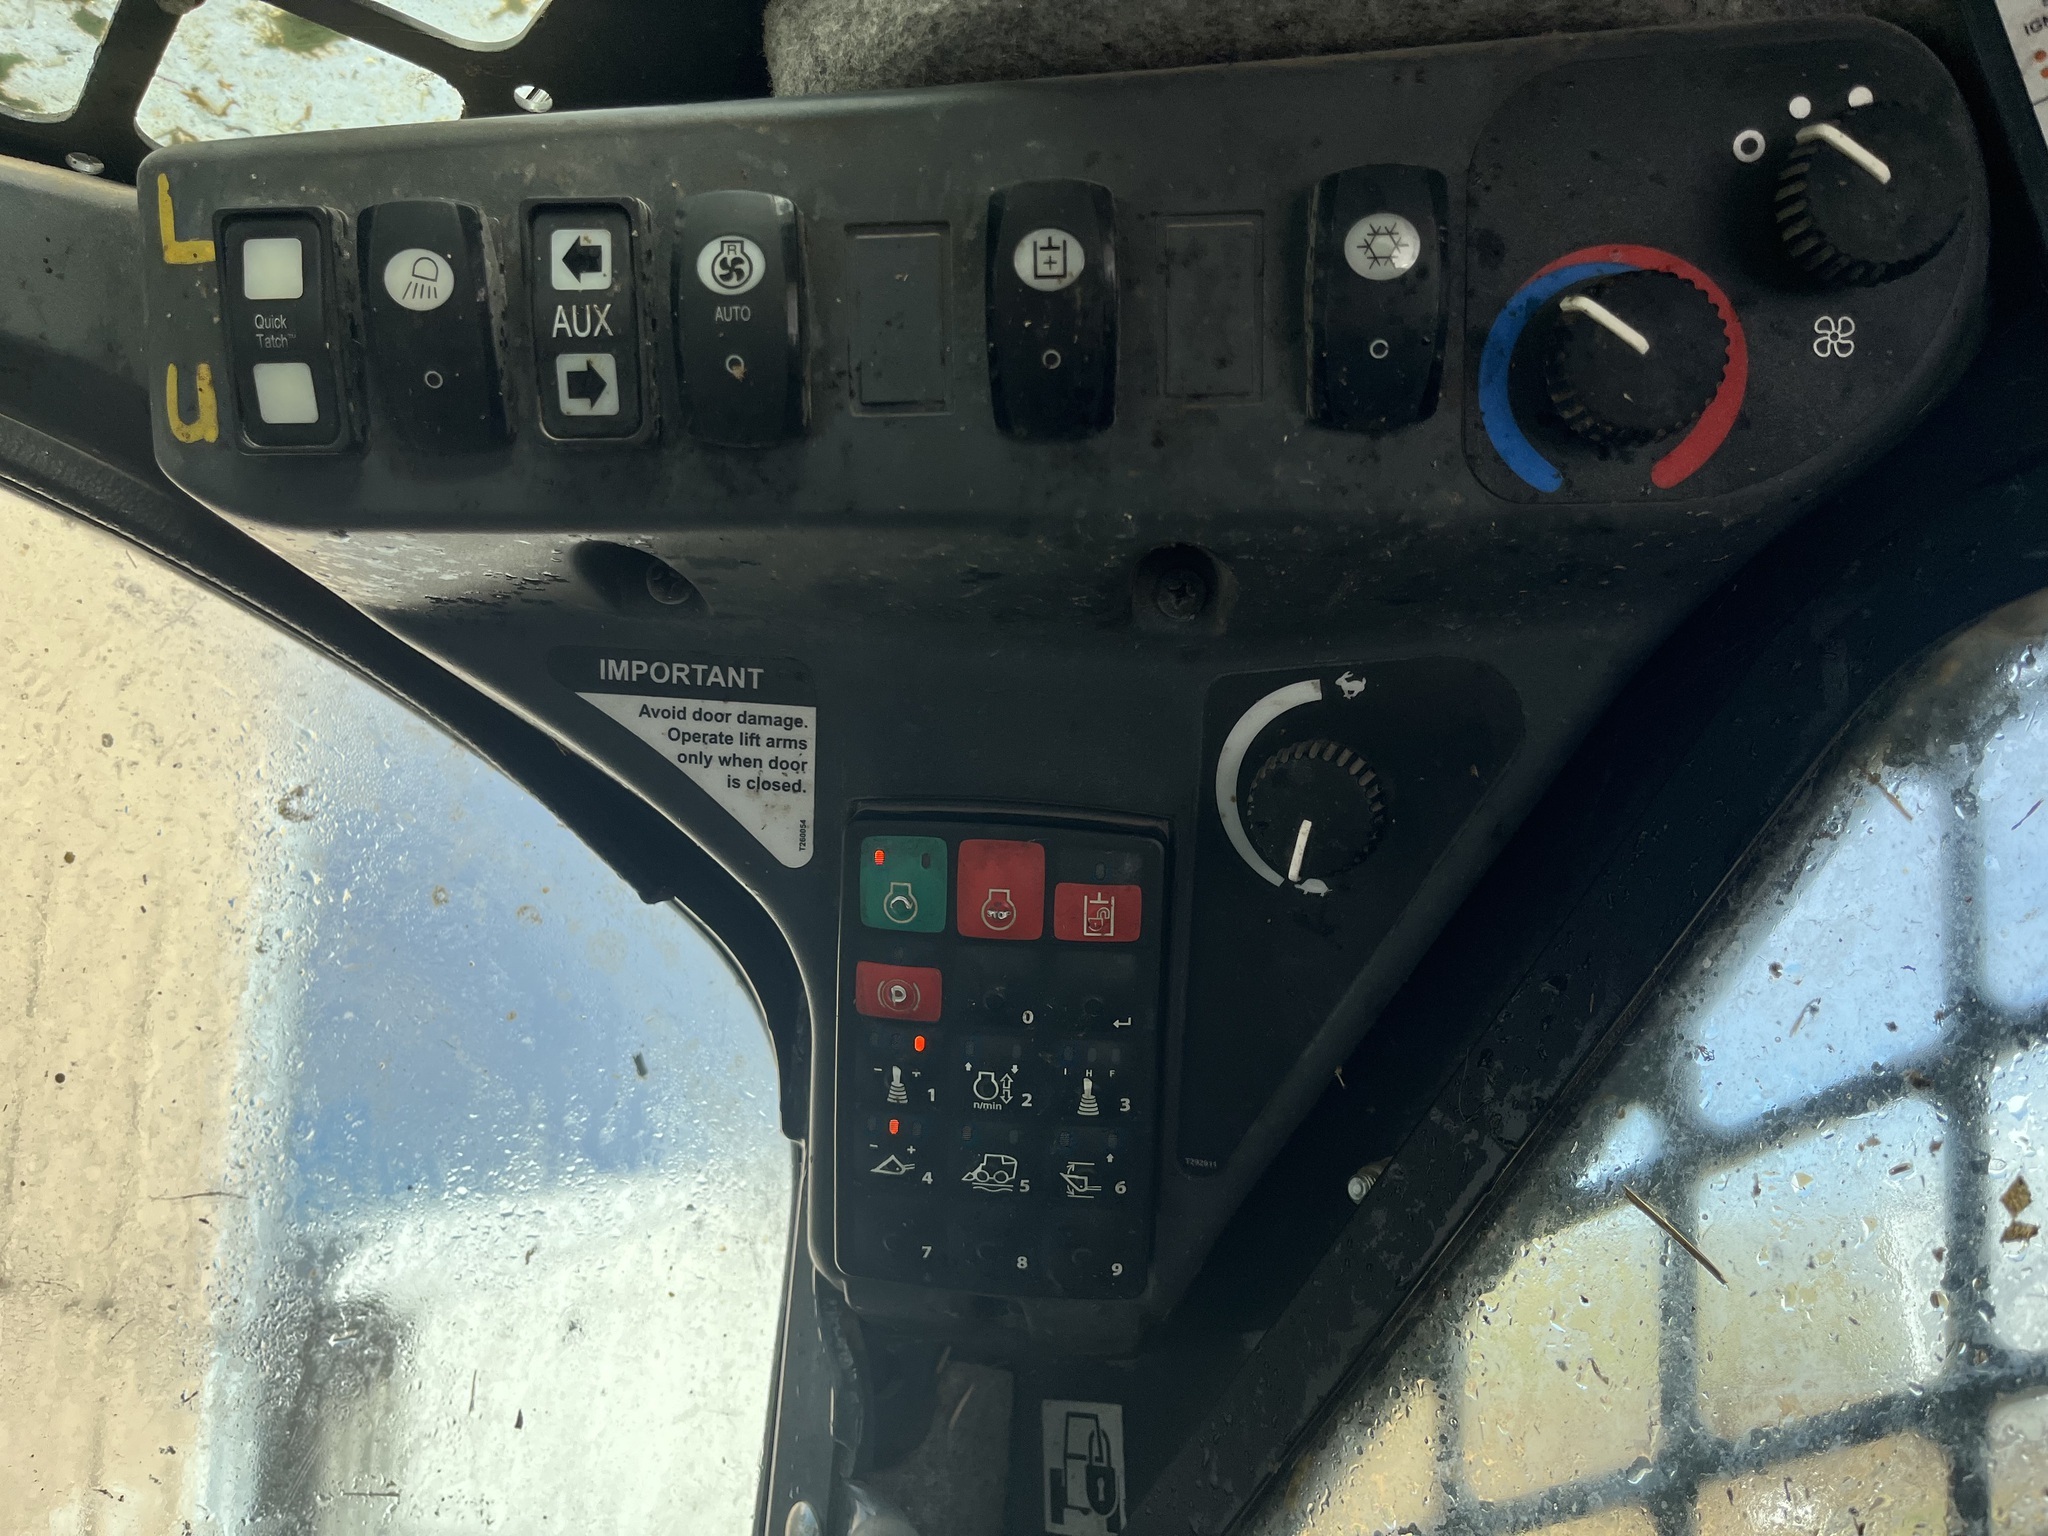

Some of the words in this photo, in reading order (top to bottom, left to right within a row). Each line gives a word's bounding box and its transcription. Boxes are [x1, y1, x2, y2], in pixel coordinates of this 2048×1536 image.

[157, 172, 216, 265] L
[727, 244, 738, 256] R
[552, 303, 613, 338] AUX
[715, 305, 751, 322] AUTO
[254, 314, 287, 330] Quick
[166, 363, 219, 443] U
[600, 658, 764, 690] IMPORTANT
[639, 704, 687, 721] Avoid
[692, 707, 732, 723] door
[736, 710, 808, 731] damage.
[667, 727, 733, 746] Operate
[739, 732, 761, 747] lift
[765, 738, 808, 750] arms
[677, 751, 713, 769] only
[718, 754, 763, 768] when
[768, 756, 808, 771] door
[727, 775, 741, 789] is
[746, 776, 807, 793] closed.
[986, 909, 1012, 920] STOP
[891, 985, 907, 1007] P
[1022, 1010, 1034, 1025] 0
[1086, 1069, 1093, 1077] H
[1109, 1069, 1115, 1077] F
[927, 1088, 936, 1102] 1
[1021, 1093, 1033, 1107] 2
[973, 1101, 1002, 1111] n/min
[1119, 1098, 1131, 1112] 3
[921, 1171, 933, 1184] 4
[1019, 1180, 1030, 1192] 5
[1115, 1181, 1127, 1194] 6
[921, 1245, 932, 1258] 7
[1016, 1256, 1028, 1269] 8
[1111, 1263, 1123, 1276] 9
